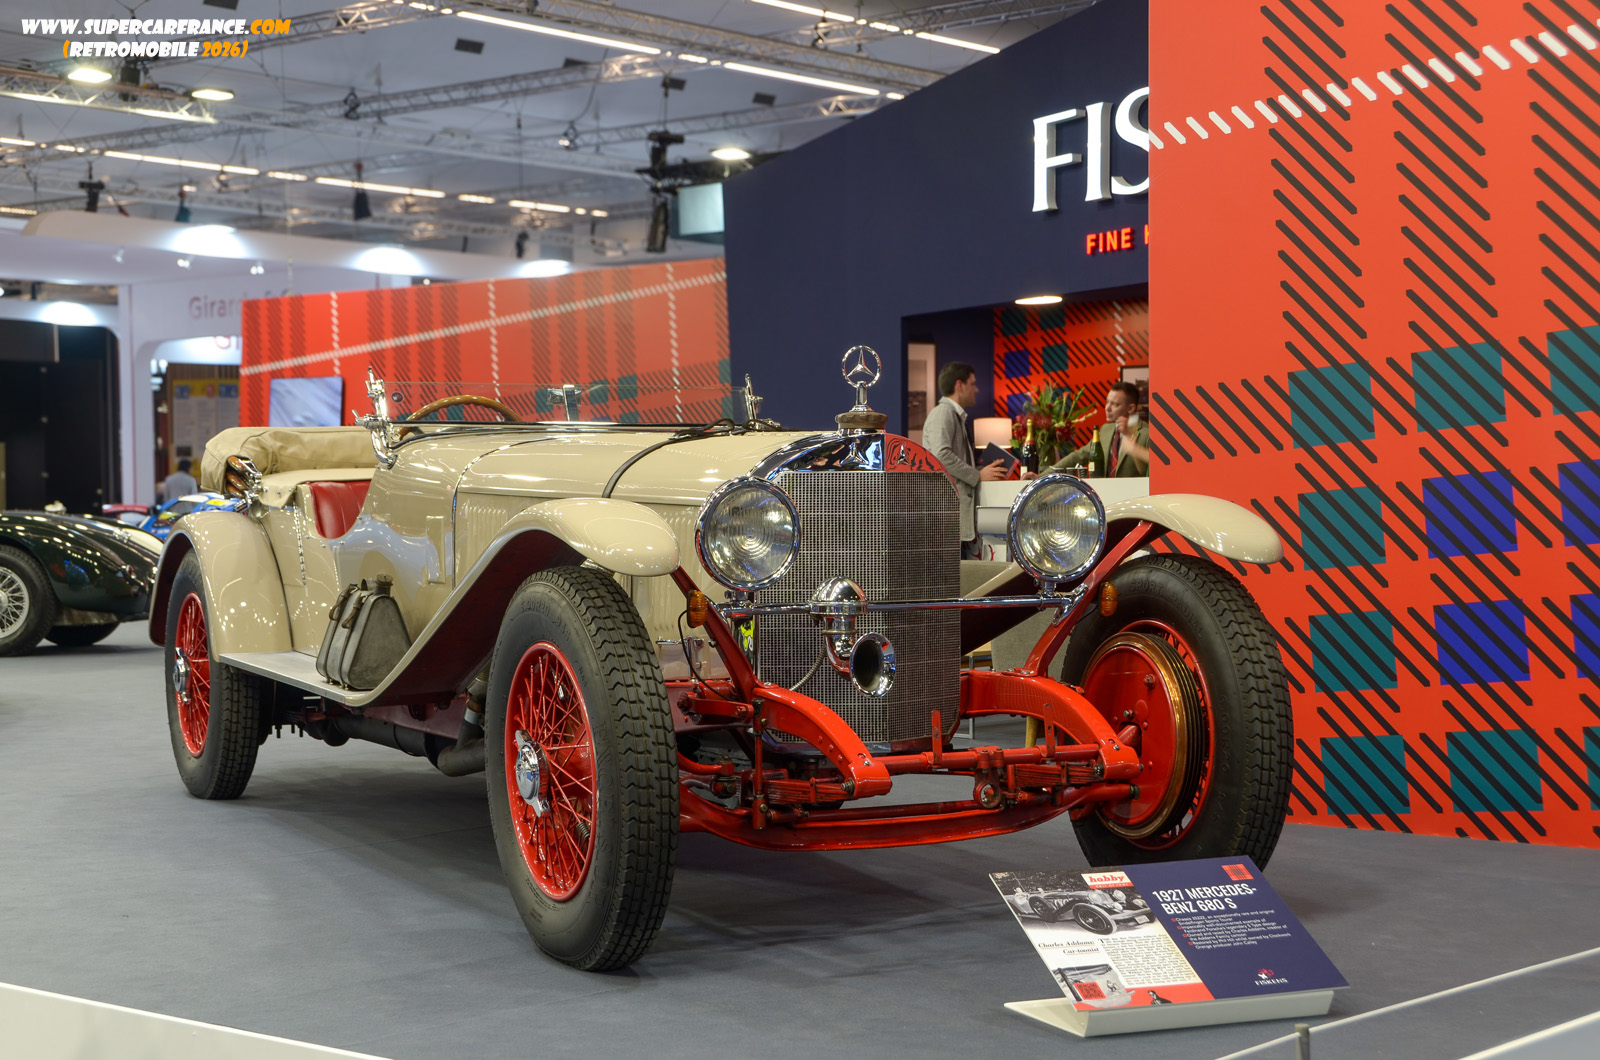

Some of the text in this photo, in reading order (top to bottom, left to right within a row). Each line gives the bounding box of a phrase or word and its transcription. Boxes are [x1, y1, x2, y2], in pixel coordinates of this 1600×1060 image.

[1086, 227, 1133, 255] FINE
[1152, 883, 1257, 902] 1927 MERCEDES-
[1161, 898, 1237, 914] BENZ 680 S
